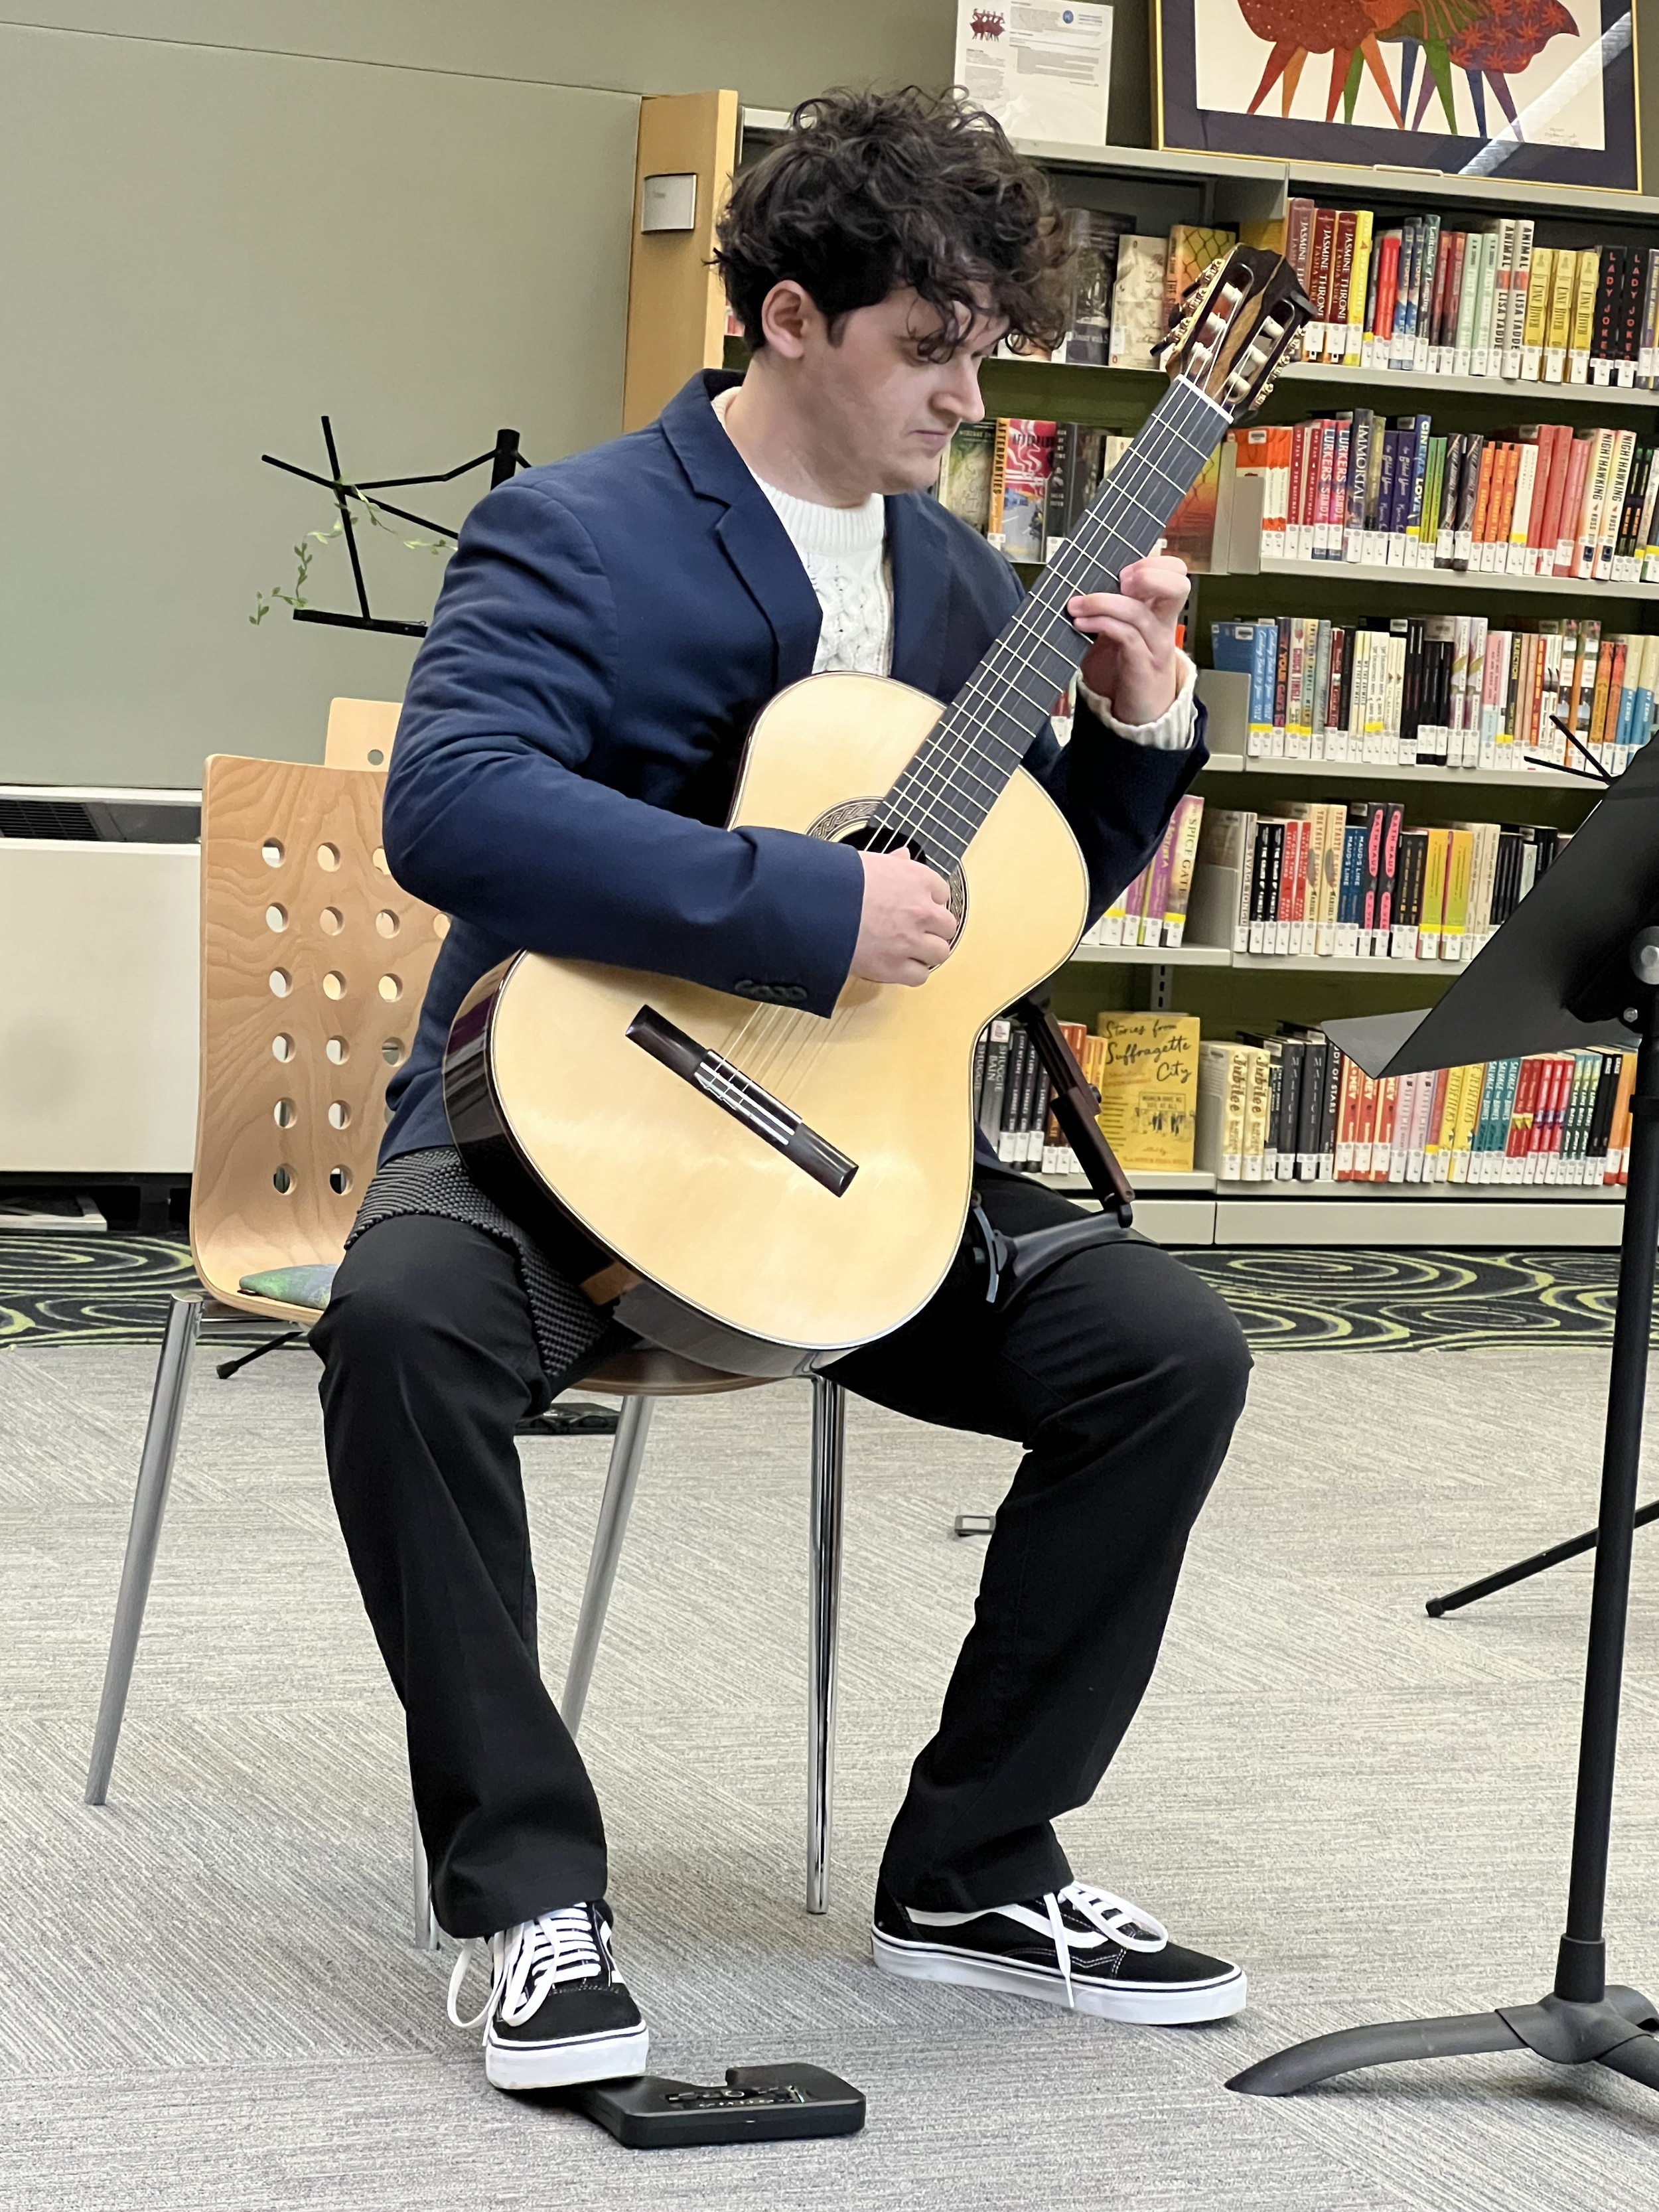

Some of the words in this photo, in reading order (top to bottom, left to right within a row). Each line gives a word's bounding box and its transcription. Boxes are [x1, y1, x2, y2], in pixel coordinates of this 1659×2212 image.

[1299, 222, 1309, 261] JASMINE
[1321, 229, 1332, 270] JASMINE
[1343, 232, 1354, 273] JASMINE
[1427, 226, 1437, 265] Latitudes
[1502, 226, 1514, 268] ANIMAL
[1520, 227, 1532, 269] ANIMAL
[1607, 252, 1616, 297] LADY
[1631, 254, 1640, 299] LADY
[1317, 275, 1328, 318] THRONE
[1338, 278, 1349, 321] THRONE
[1421, 277, 1432, 313] Longing
[1498, 292, 1507, 314] LISA
[1515, 293, 1525, 315] LISA
[1494, 319, 1505, 350] TADDE
[1512, 320, 1523, 350] TADDE
[1530, 305, 1543, 328] RIVER
[1554, 308, 1567, 330] RIVER
[1577, 313, 1591, 335] RIVER
[993, 422, 1007, 494] AFTERPARTIES
[1321, 428, 1334, 482] LURKERS
[1337, 429, 1350, 483] LURKERS
[1354, 424, 1370, 503] IMMORTAL
[1416, 420, 1430, 475] CINEMA
[1593, 433, 1613, 500] NIGHTHAWKING
[1613, 435, 1632, 502] NIGHTHAWKING
[1320, 487, 1331, 518] SANDI
[1334, 488, 1345, 520] SANDI
[1413, 477, 1424, 512] LOVE
[1278, 652, 1287, 682] YOUR
[1512, 638, 1521, 680] REJECTION
[1185, 818, 1198, 856] SPICE
[1179, 859, 1192, 896] GATE
[1241, 891, 1250, 926] TONGU
[1102, 1020, 1145, 1039] Stories
[1152, 1019, 1177, 1038] from
[987, 1055, 998, 1081] BAIN
[995, 1045, 1008, 1092] SHUGGIE
[1105, 1035, 1192, 1067] Suffragette
[1156, 1060, 1192, 1084] City
[1230, 1055, 1247, 1112] Jubilee
[1252, 1056, 1269, 1114] Jubilee
[1289, 1056, 1299, 1124] MALICE
[1311, 1057, 1322, 1124] MALICE
[1333, 1068, 1339, 1081] OF
[1486, 1062, 1497, 1089] SALVAGE
[1496, 1061, 1508, 1090] SALVAGE
[1507, 1061, 1519, 1090] SALVAGE
[1492, 1100, 1501, 1120] BONES
[1502, 1100, 1513, 1120] BONES
